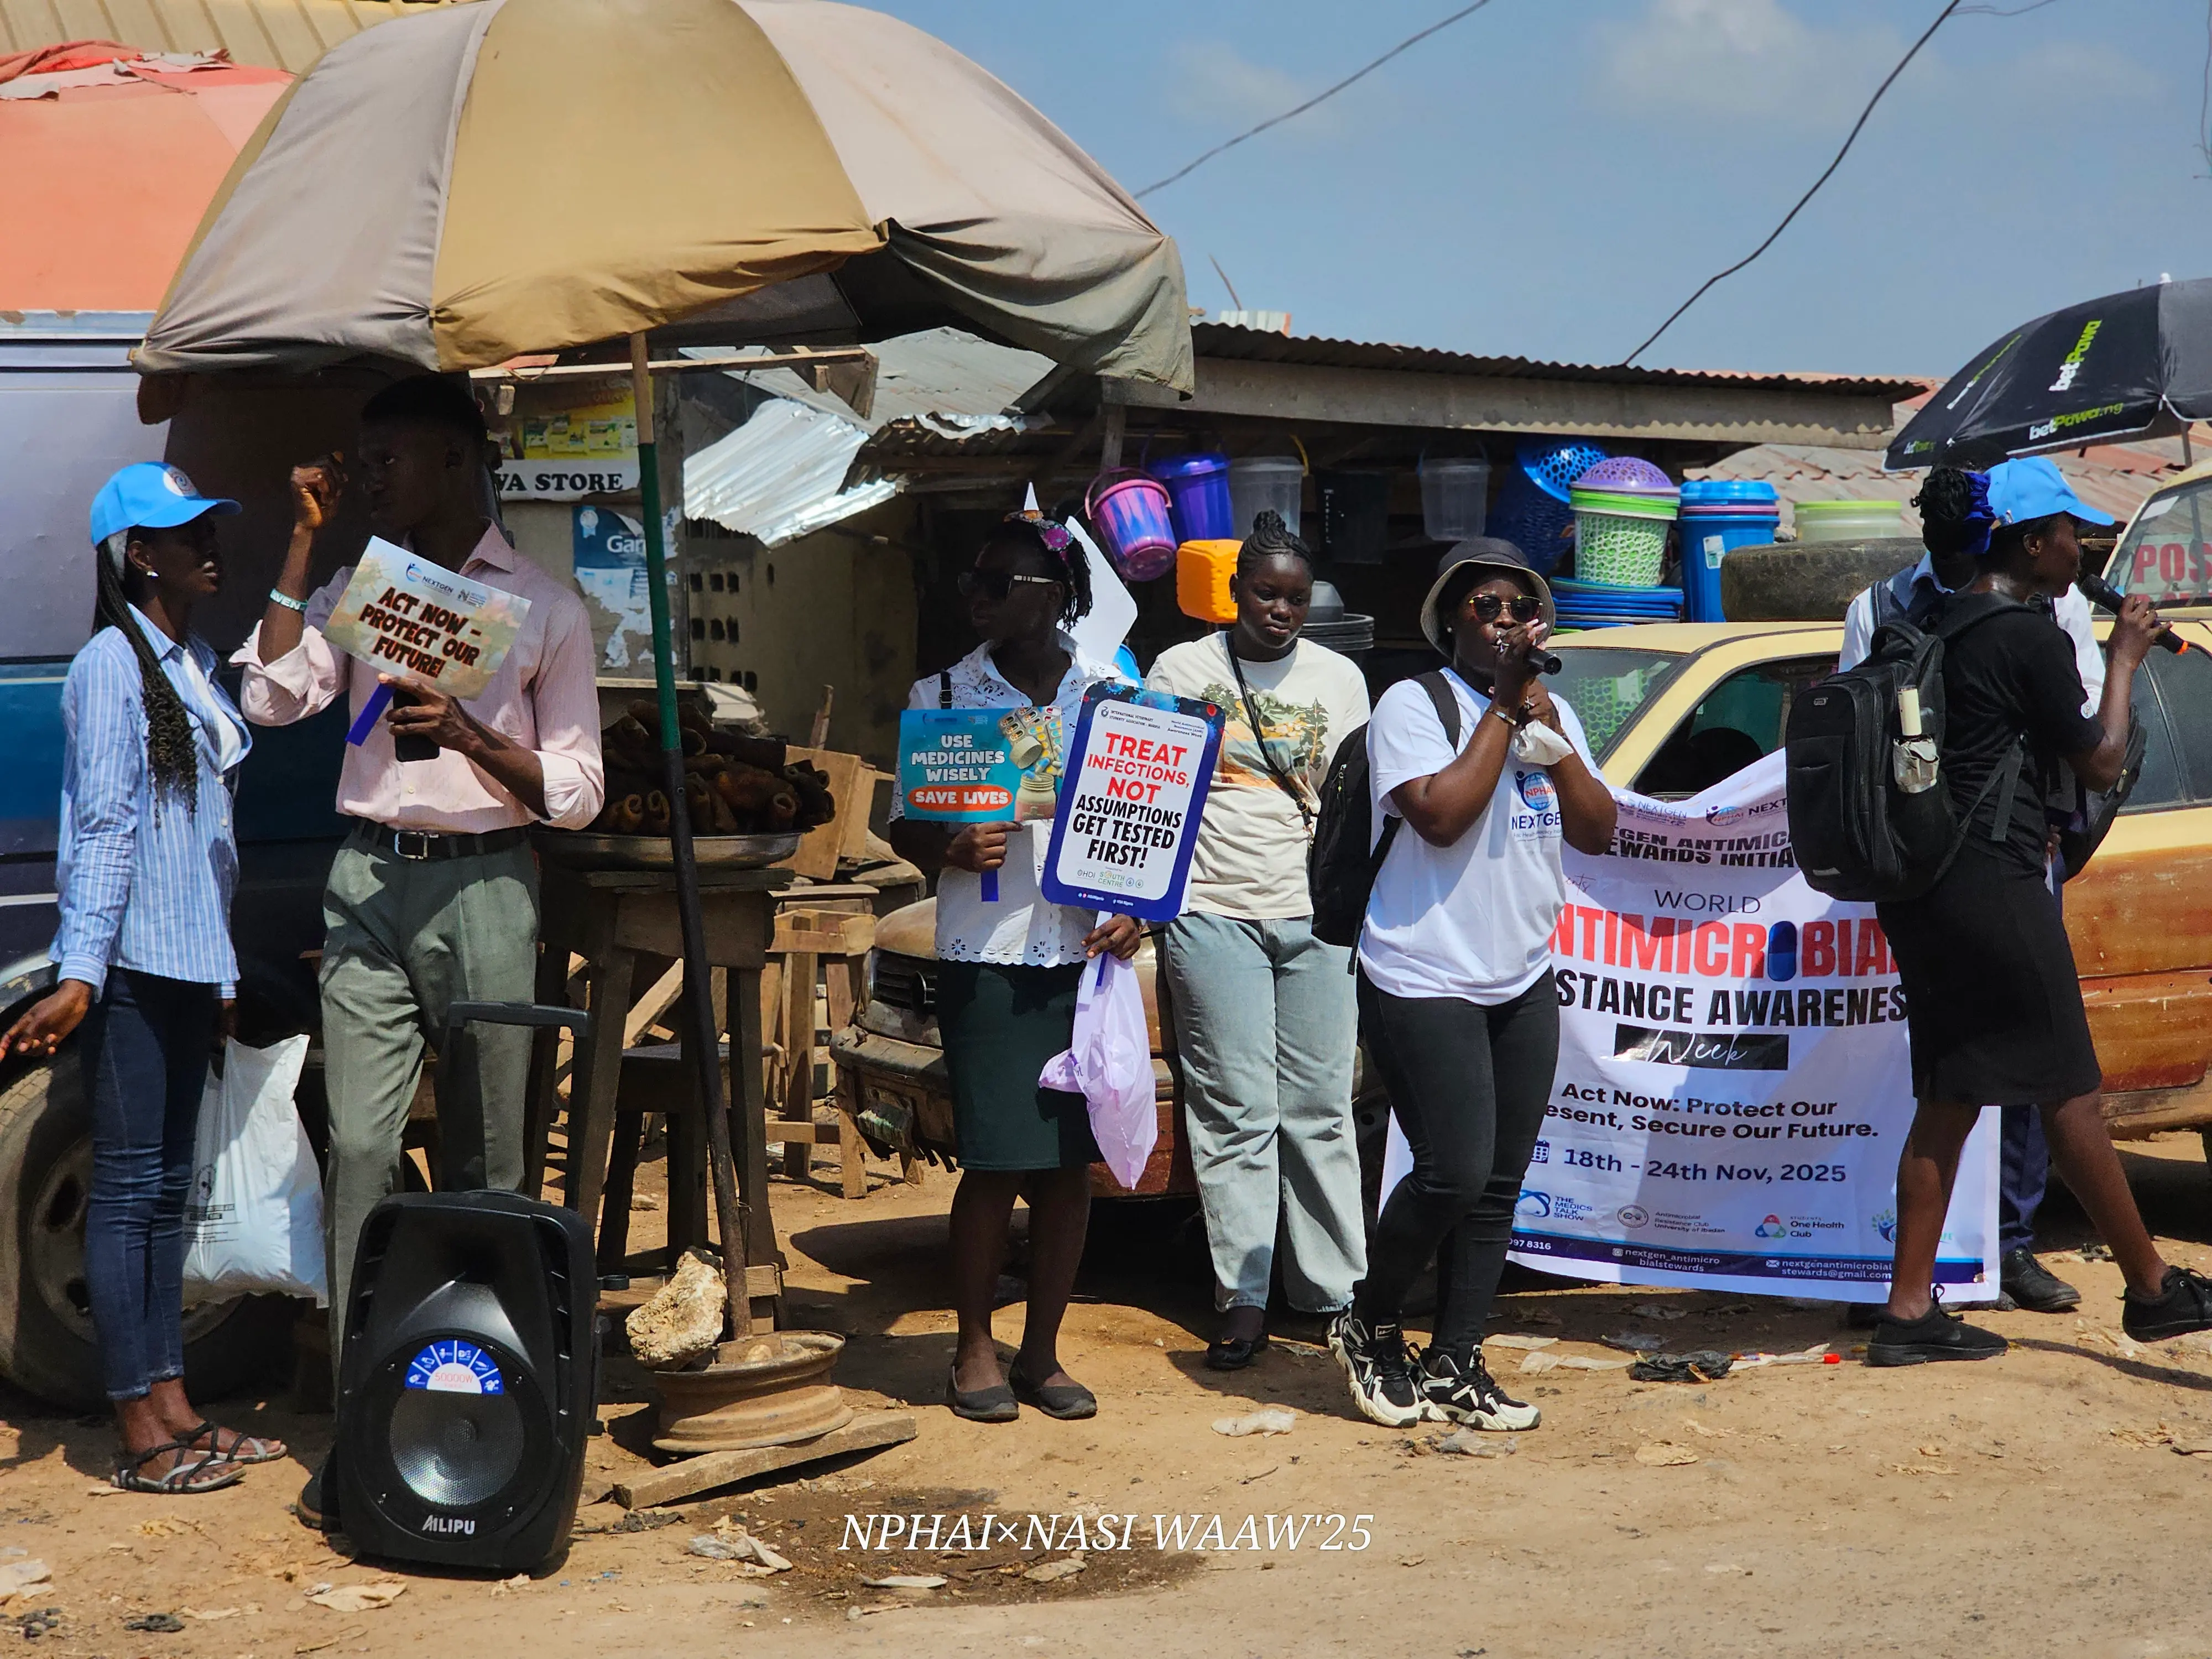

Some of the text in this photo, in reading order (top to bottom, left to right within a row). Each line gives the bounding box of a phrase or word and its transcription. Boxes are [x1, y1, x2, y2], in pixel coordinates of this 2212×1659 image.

[535, 473, 623, 492] STORE
[422, 576, 453, 594] NEXTGEN
[377, 586, 420, 615] ACT
[419, 603, 469, 636] NOW
[358, 603, 481, 667] PROTECT OUR
[371, 635, 446, 679] FUTURE!
[941, 734, 973, 748] USE
[1105, 733, 1187, 767] TREAT
[911, 751, 1005, 766] MEDICINES
[926, 768, 990, 782] WISELY
[1087, 754, 1190, 789] INFECTIONS,
[915, 791, 1008, 805] SAVE LIVES
[1107, 776, 1162, 804] NOT
[1075, 794, 1182, 828] ASSUMPTIONS
[1639, 801, 1687, 818] NEXTGEN
[1073, 813, 1175, 849] GET TESTED
[1615, 827, 1791, 851] GEN ANTIMIC
[1087, 839, 1149, 869] FIRST!
[1721, 847, 1794, 868] INITIA
[1098, 878, 1124, 888] CENTRE
[1654, 889, 1761, 914] WORLD
[1547, 902, 1899, 982] NTIMICROBIA
[1556, 968, 1908, 1027] STANCE AWARENES
[1645, 1030, 1747, 1066] Week
[1562, 1083, 1838, 1118] Act Now: Protect Our
[1546, 1105, 1879, 1139] esent, Secure Our Future.
[1564, 1149, 1622, 1172] 18th
[1647, 1160, 1707, 1181] 24th
[1716, 1165, 1772, 1185] Nov,
[1780, 1165, 1846, 1182] 2025
[1555, 1196, 1574, 1204] THE
[1555, 1202, 1593, 1212] MEDICS
[1553, 1212, 1584, 1221] SHOW
[1554, 1207, 1578, 1215] TALK
[1655, 1212, 1700, 1220] Antimicrobial
[1655, 1223, 1689, 1233] University
[1812, 1221, 1844, 1229] Health
[1526, 1240, 1552, 1250] 8316
[1625, 1248, 1720, 1265] nextgen_antimicro
[1640, 1258, 1705, 1272] bialstewards
[1782, 1260, 1893, 1272] nextgenantimicrobial
[1782, 1268, 1892, 1279] stewards@gmail.com
[434, 1372, 474, 1384] 50000W
[422, 1514, 476, 1535] AILIPU
